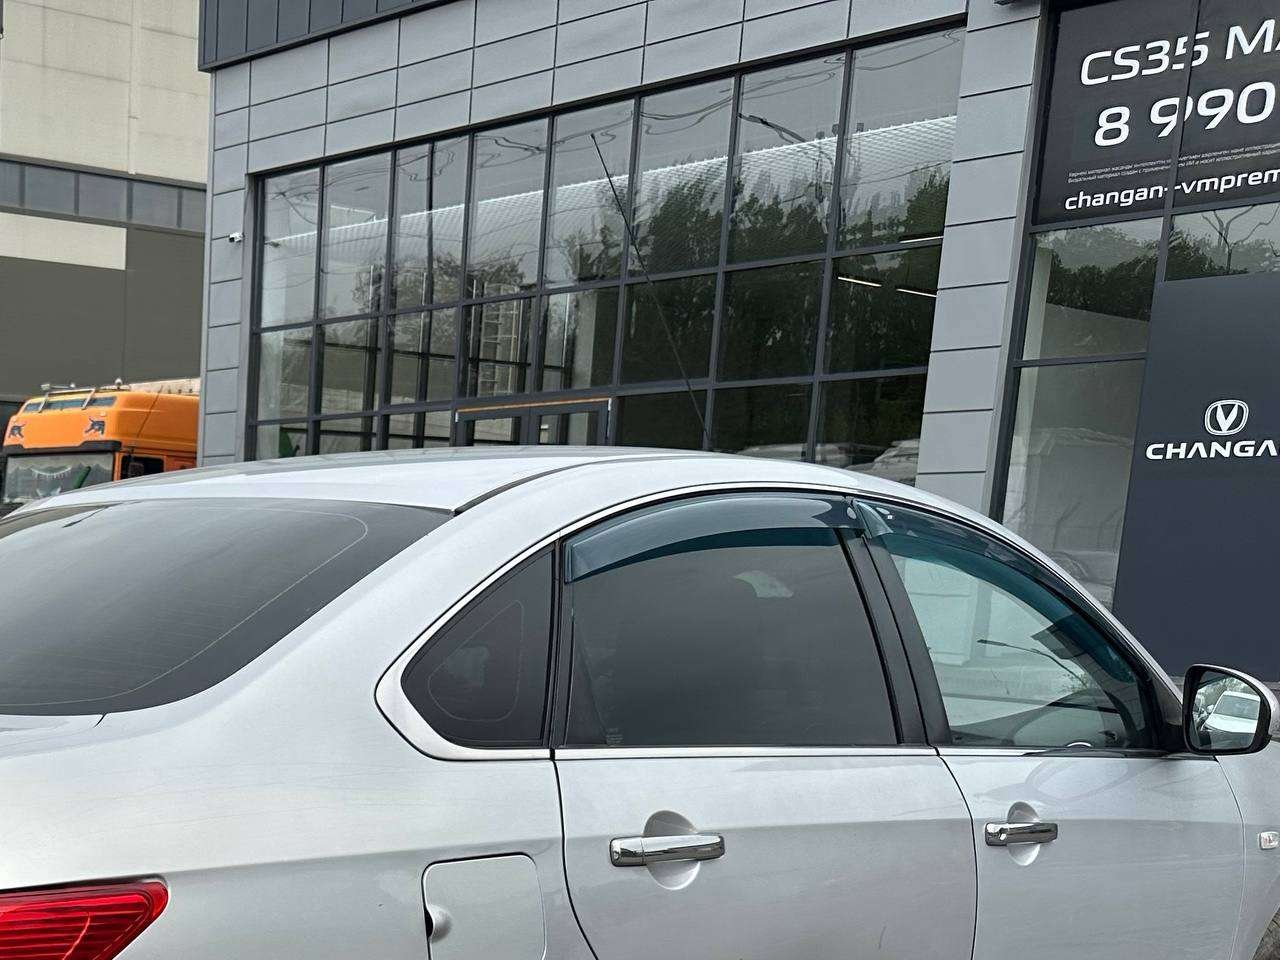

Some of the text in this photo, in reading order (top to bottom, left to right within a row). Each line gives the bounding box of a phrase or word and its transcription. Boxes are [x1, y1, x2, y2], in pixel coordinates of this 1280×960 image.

[1081, 19, 1280, 86] CS35 M
[1094, 81, 1276, 147] 8 990
